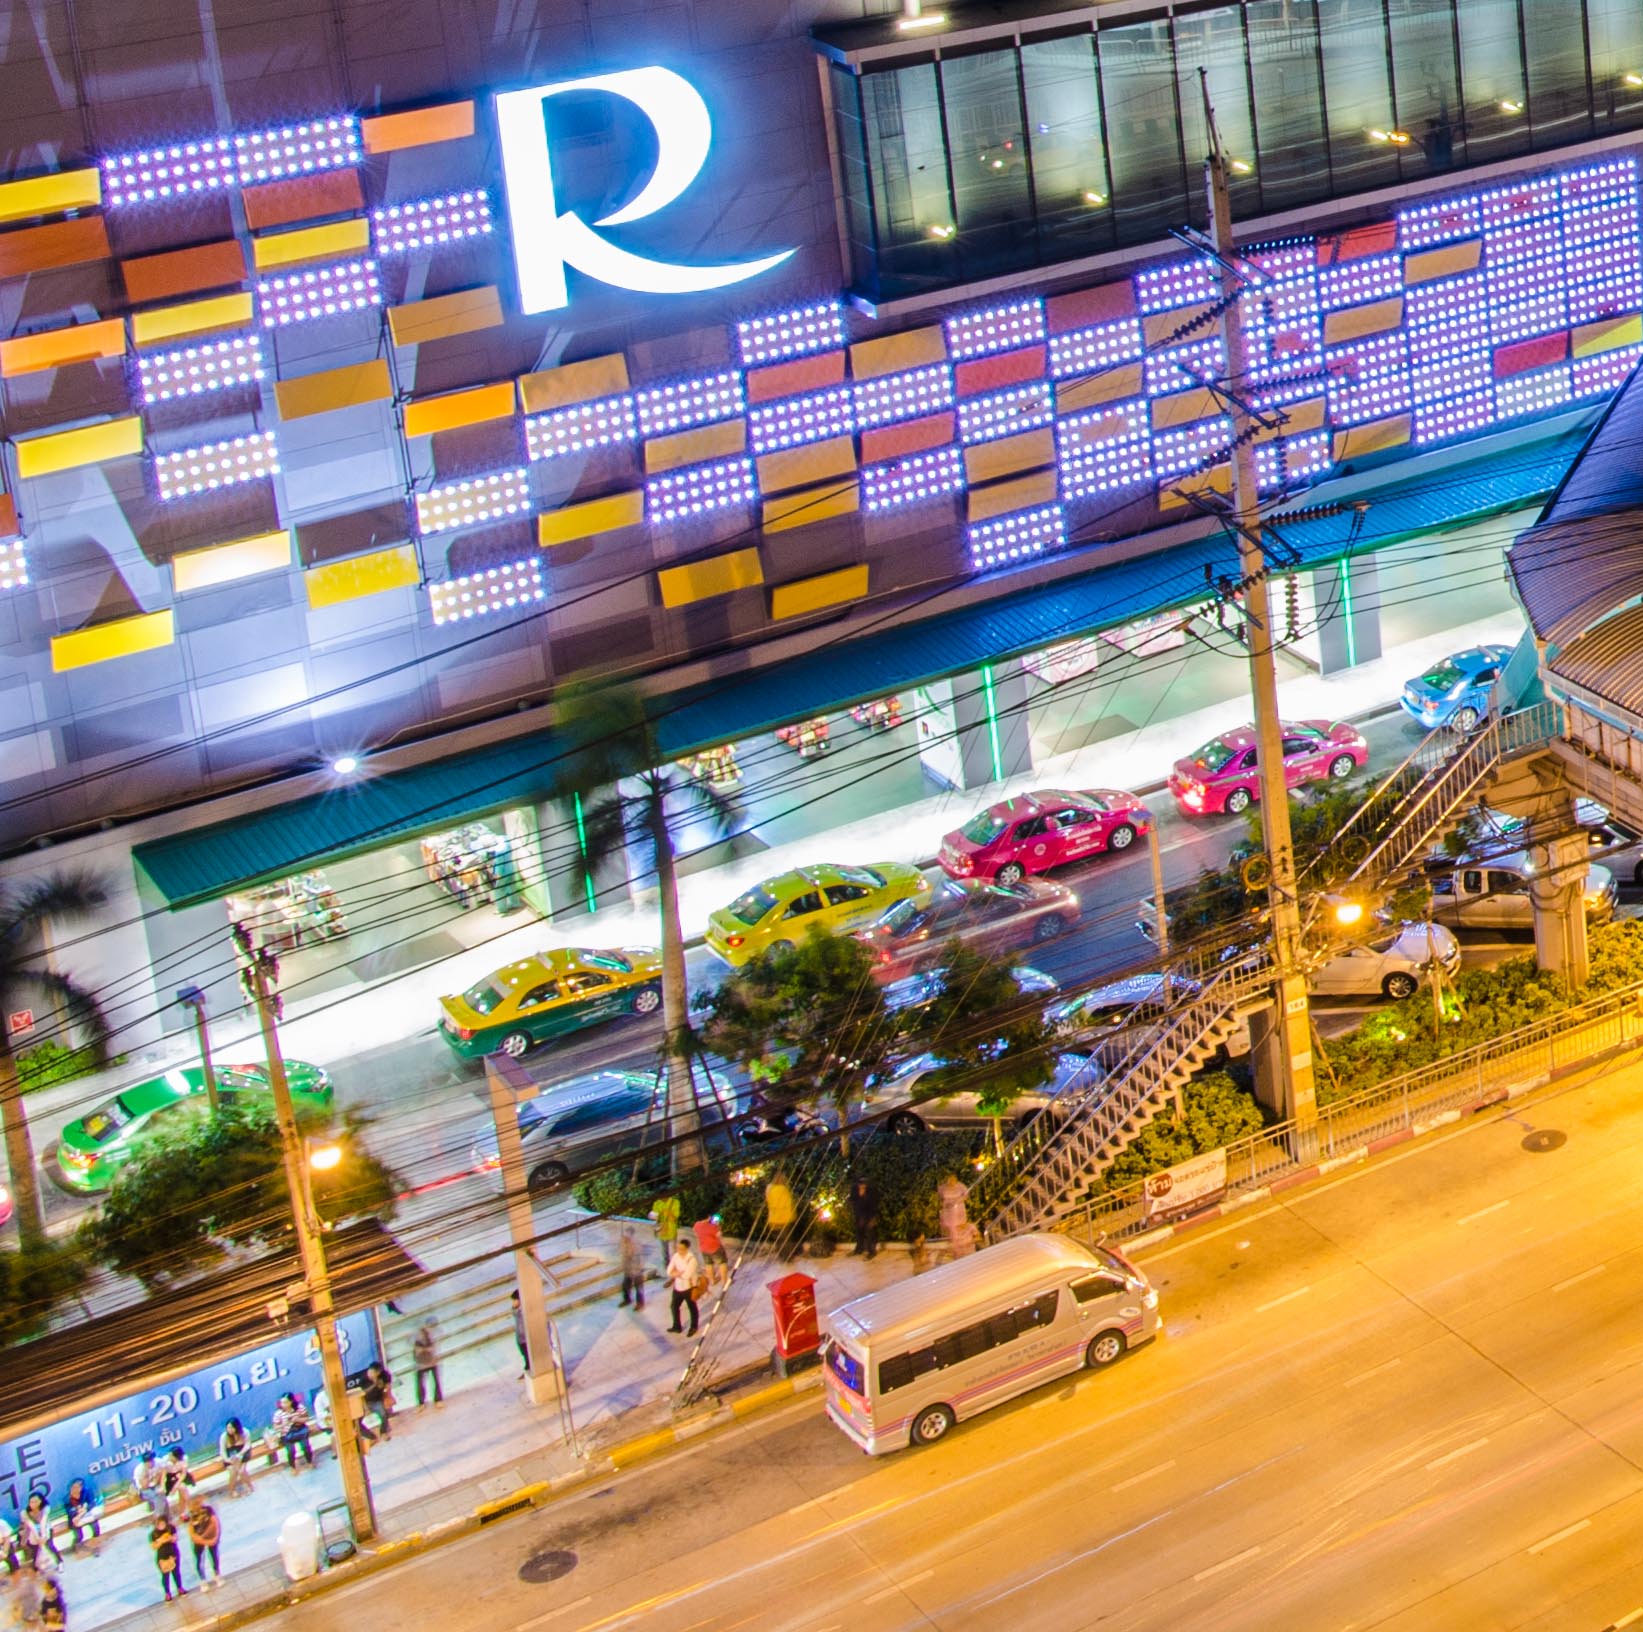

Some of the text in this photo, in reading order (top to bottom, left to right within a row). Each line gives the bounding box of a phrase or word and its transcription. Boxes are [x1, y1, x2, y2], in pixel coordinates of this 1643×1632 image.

[495, 64, 801, 316] R
[82, 1384, 200, 1450] 11-20
[212, 1356, 289, 1402] ก.ย.
[87, 1437, 153, 1475] ลานน้ำพ
[188, 1420, 199, 1437] 1
